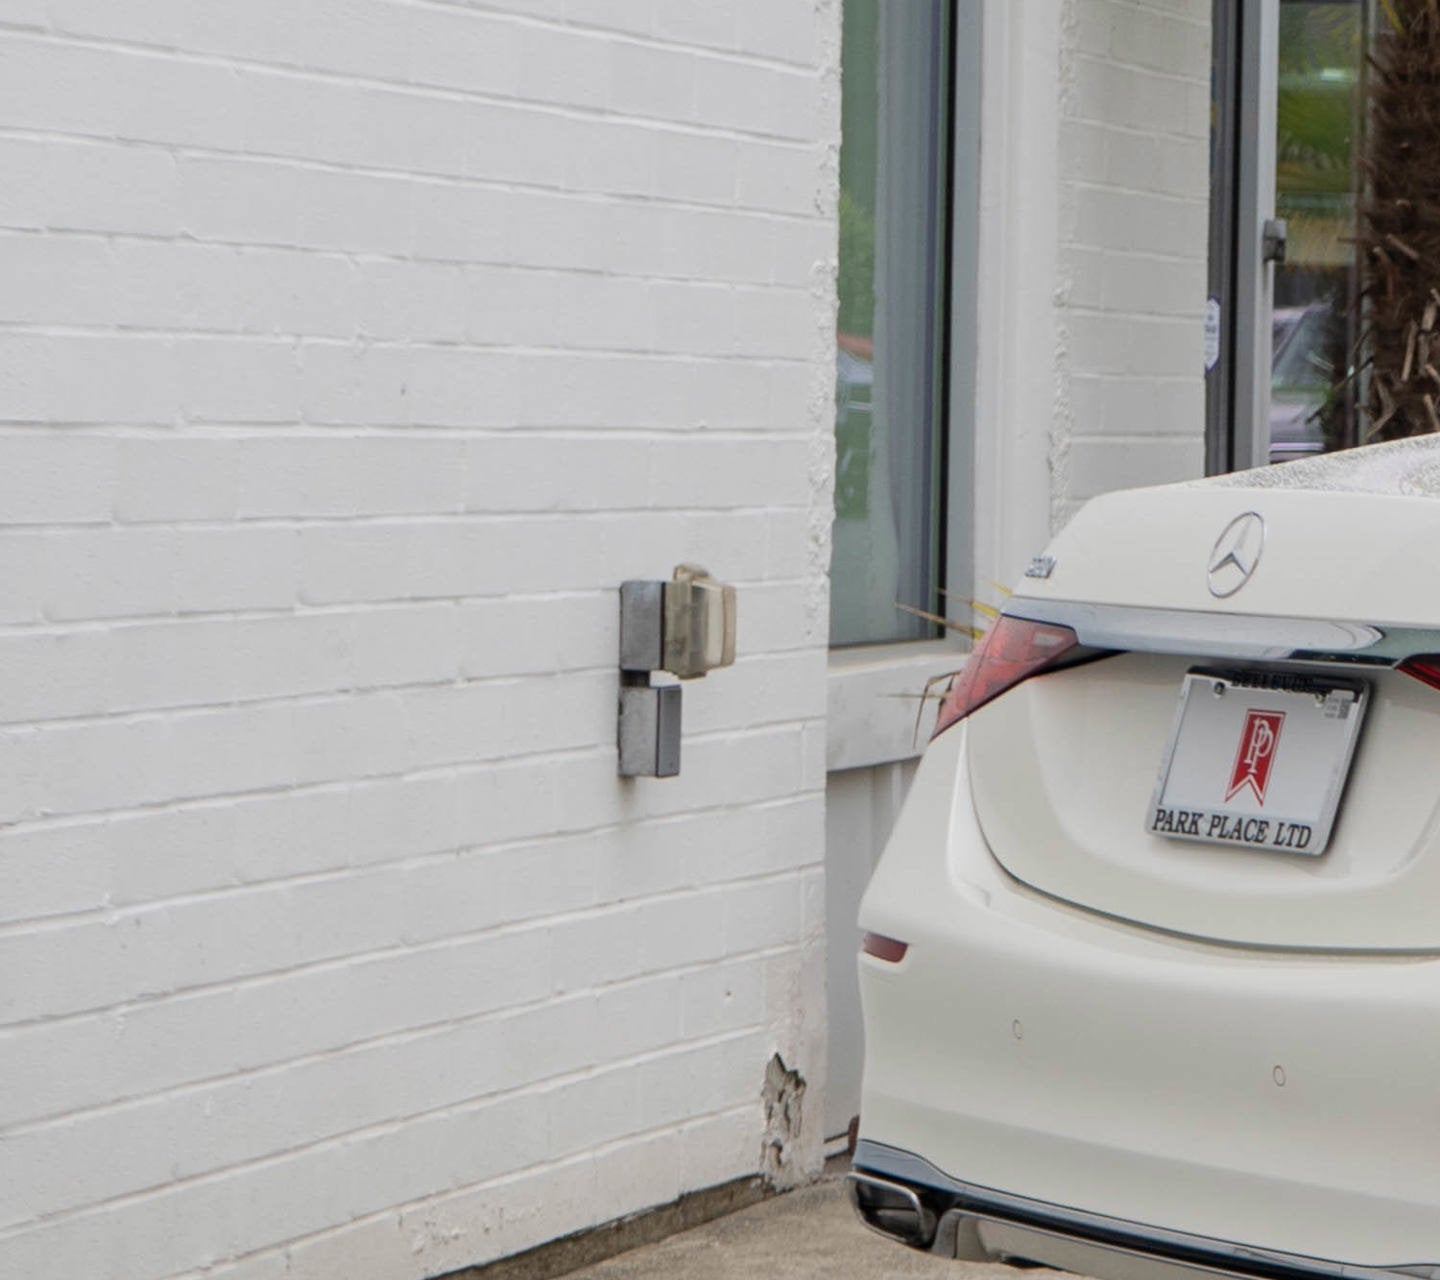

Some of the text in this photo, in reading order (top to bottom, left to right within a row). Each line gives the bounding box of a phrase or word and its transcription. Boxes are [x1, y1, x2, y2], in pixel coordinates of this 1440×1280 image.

[1152, 808, 1312, 849] PARK PLACE LTD
